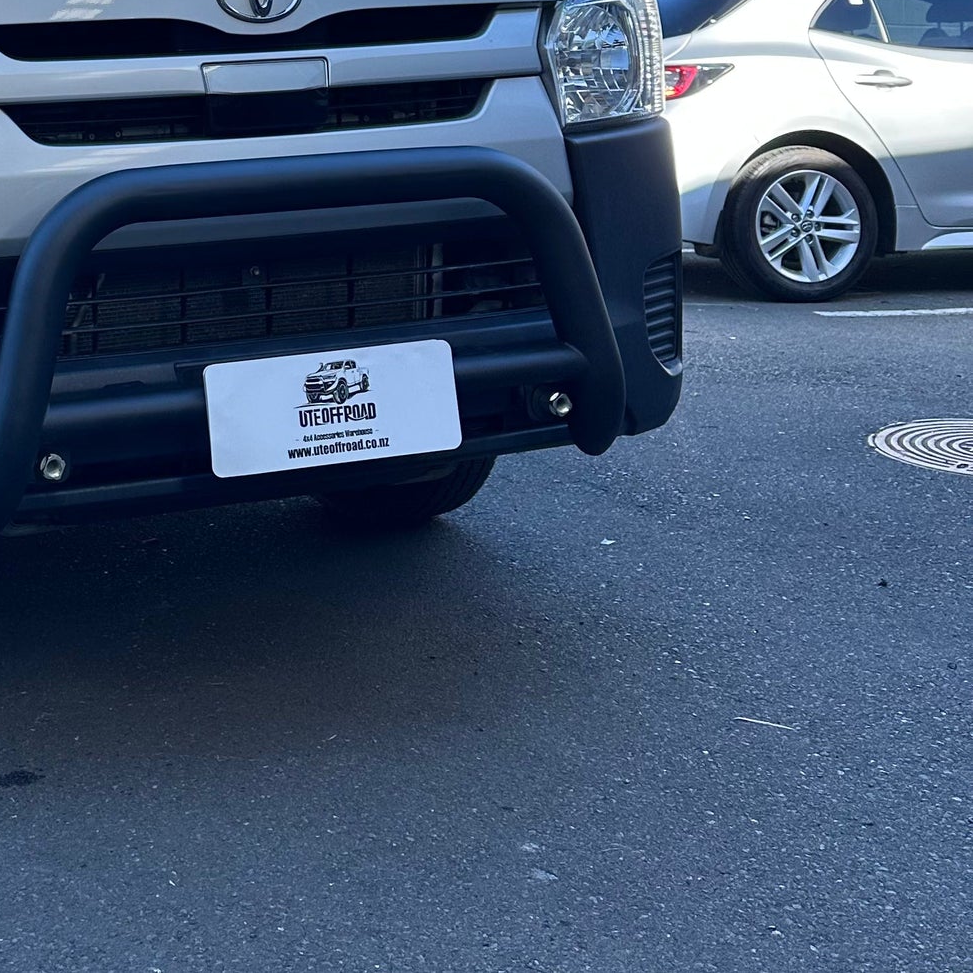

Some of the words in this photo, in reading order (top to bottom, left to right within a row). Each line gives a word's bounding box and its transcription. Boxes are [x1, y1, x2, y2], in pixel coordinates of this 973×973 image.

[299, 402, 377, 428] UTEOFFROAD
[303, 434, 313, 442] 4x4
[314, 431, 345, 441] Accessories
[345, 428, 373, 437] Warehouse
[287, 437, 390, 459] www.uteoffroad.co.nz
